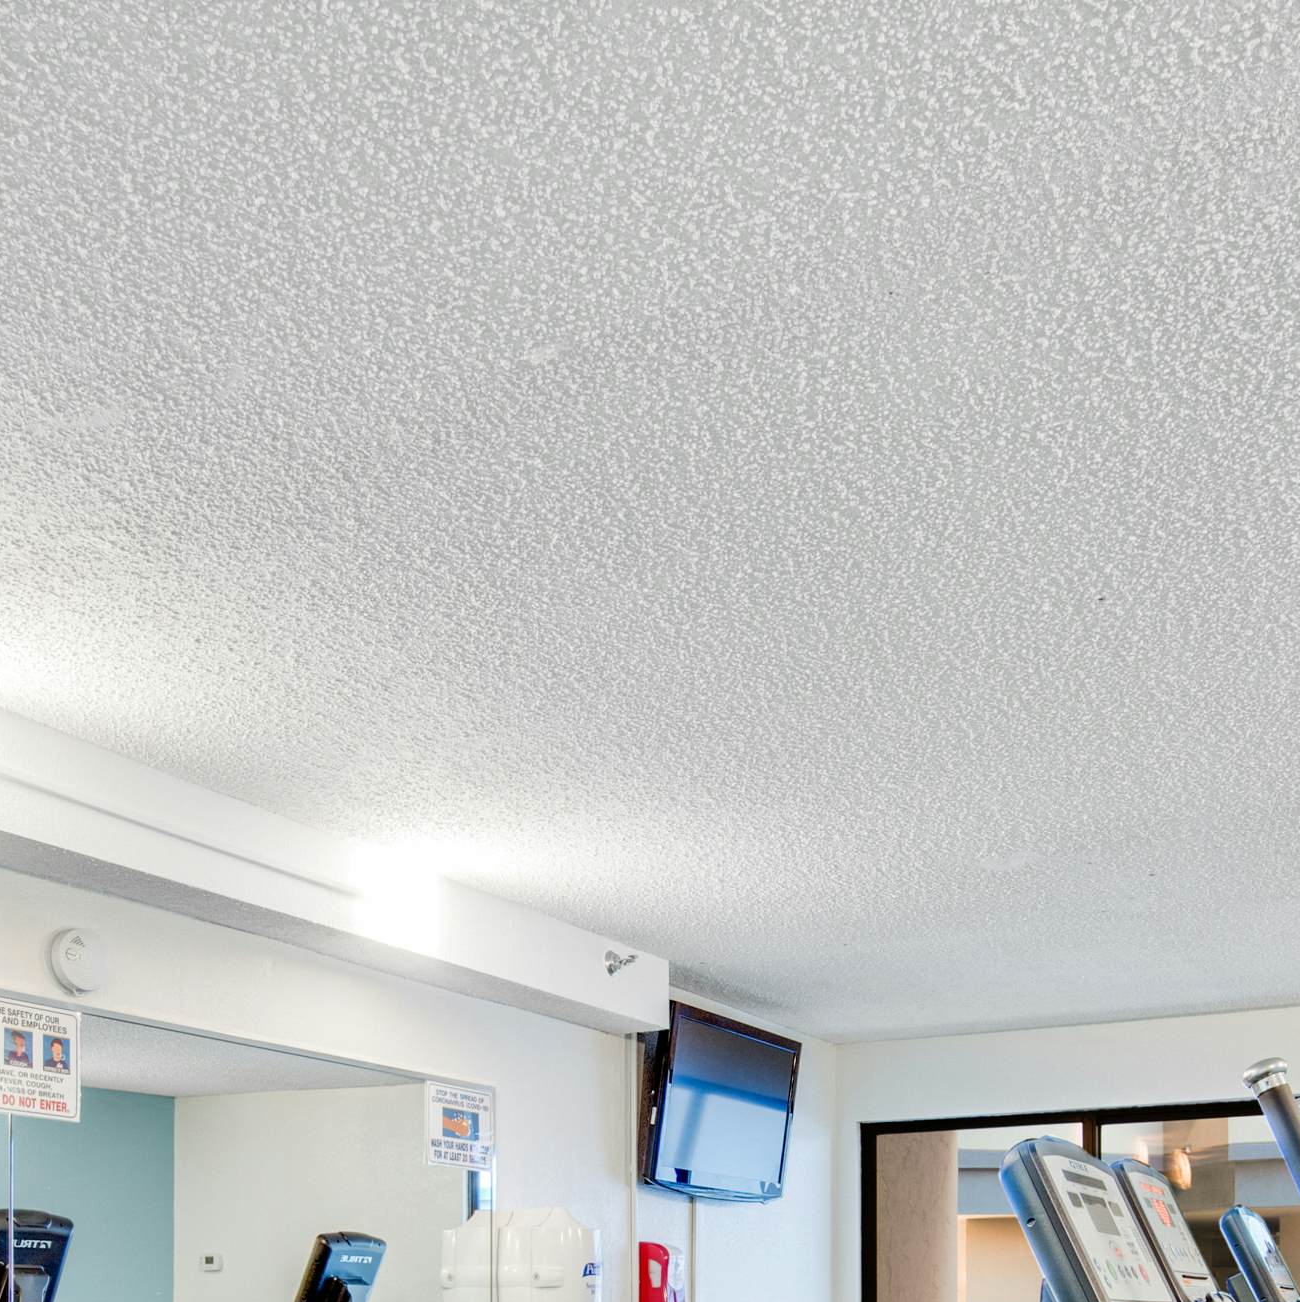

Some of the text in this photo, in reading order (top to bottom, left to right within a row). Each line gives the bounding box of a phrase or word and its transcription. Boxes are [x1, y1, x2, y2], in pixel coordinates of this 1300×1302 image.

[7, 1008, 33, 1019] SAFETY
[34, 1013, 43, 1021] OF
[45, 1015, 60, 1025] OUR
[1, 1016, 19, 1026] AND
[21, 1020, 68, 1035] EMPLOYEES
[30, 1072, 64, 1084] RECENTLY
[27, 1088, 37, 1096] OF
[39, 1091, 65, 1099] BREATH
[2, 1094, 16, 1106] DO
[19, 1096, 37, 1108] NOT
[40, 1099, 70, 1113] ENTER.
[443, 1140, 454, 1150] YOUR
